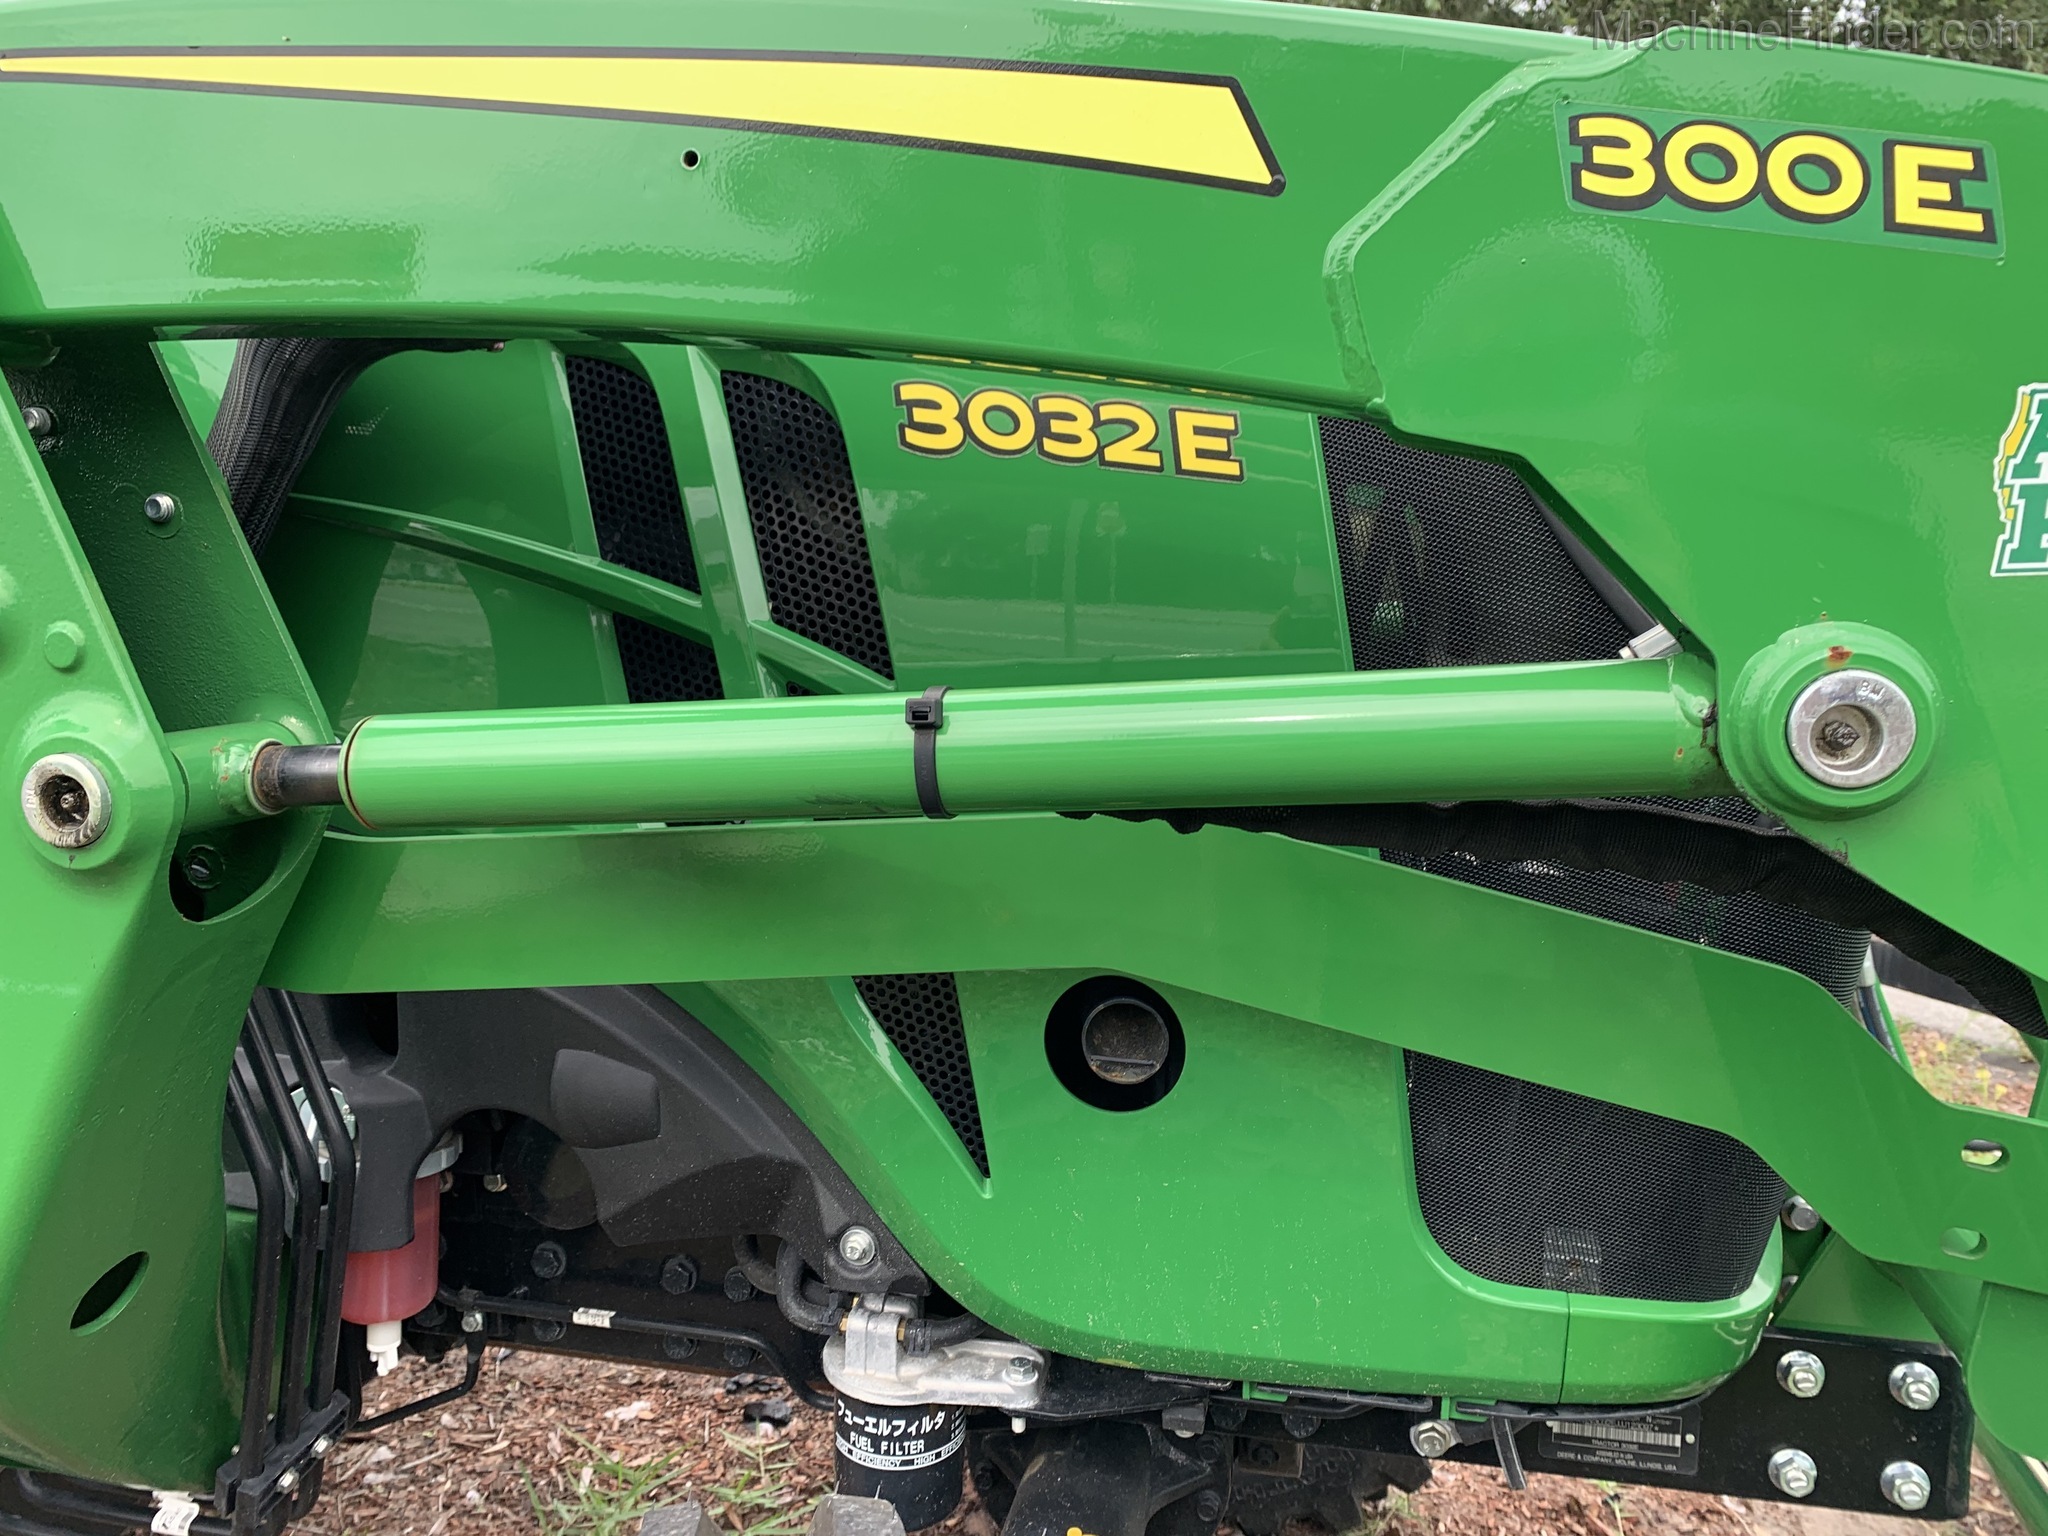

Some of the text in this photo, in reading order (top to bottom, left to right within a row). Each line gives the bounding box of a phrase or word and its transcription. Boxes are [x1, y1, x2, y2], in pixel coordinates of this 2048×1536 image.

[837, 1399, 946, 1437] フューエルフィルタ
[850, 1431, 925, 1456] FUEL FILTER
[852, 1449, 902, 1468] EFFICIENCY
[913, 1453, 936, 1467] HIGH
